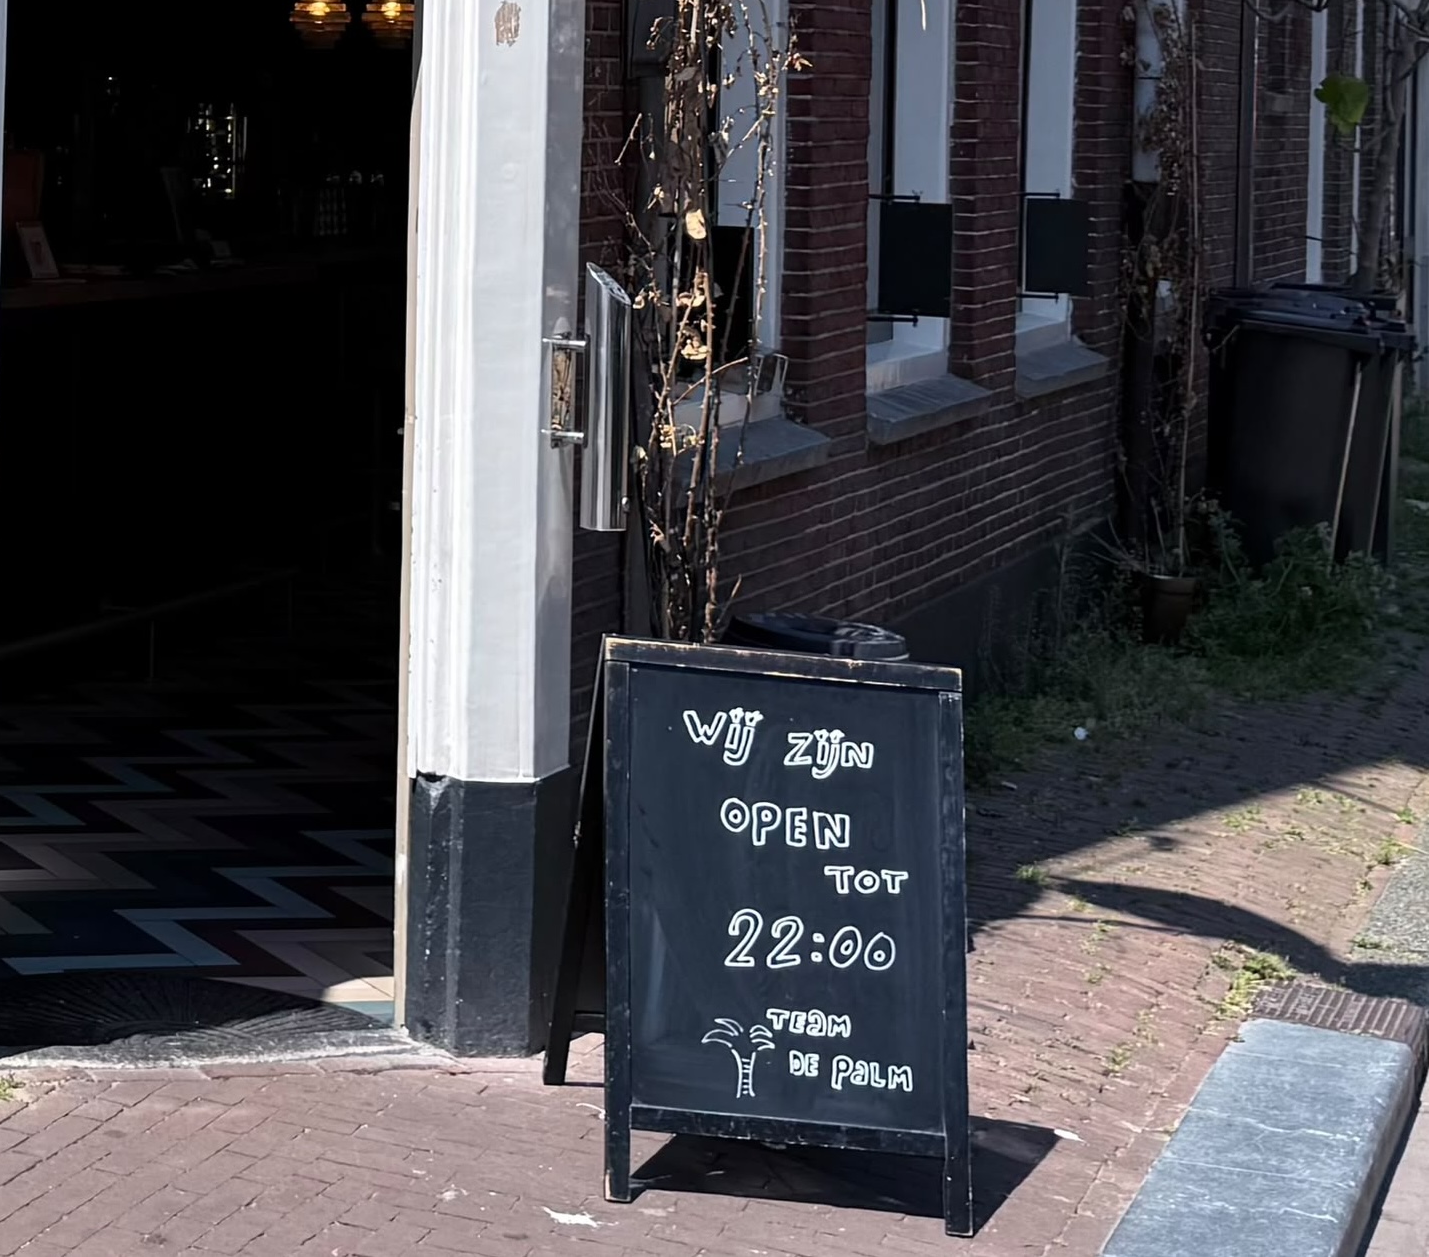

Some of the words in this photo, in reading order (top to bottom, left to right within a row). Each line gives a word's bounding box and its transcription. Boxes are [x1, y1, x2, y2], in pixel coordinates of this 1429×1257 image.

[720, 797, 850, 850] OPEN
[824, 865, 909, 894] TOT
[724, 908, 896, 971] 22:00
[789, 1049, 820, 1077] DE
